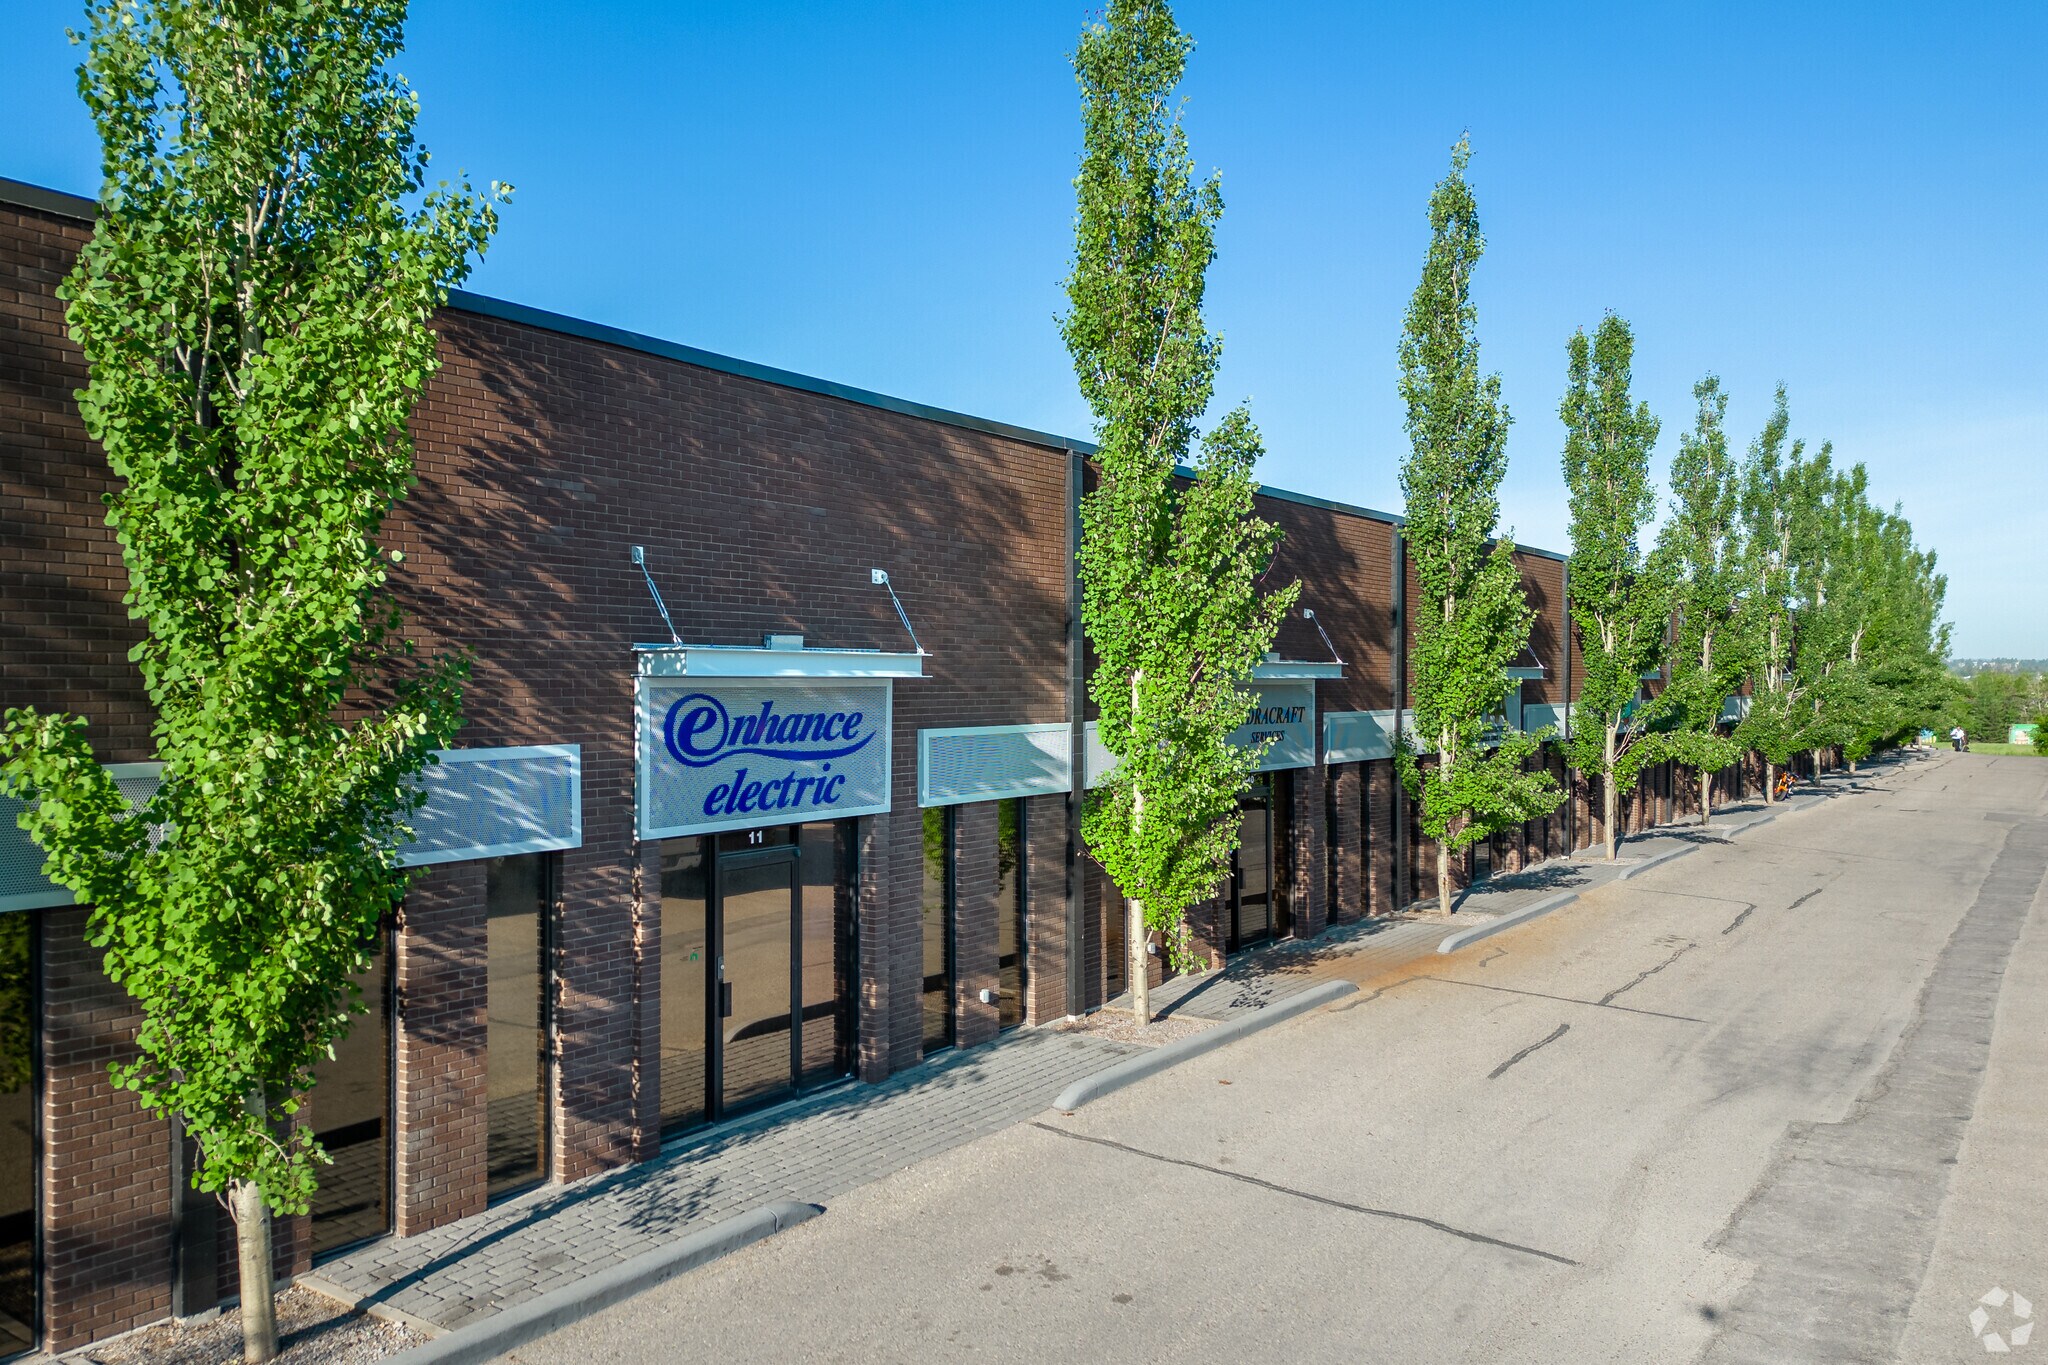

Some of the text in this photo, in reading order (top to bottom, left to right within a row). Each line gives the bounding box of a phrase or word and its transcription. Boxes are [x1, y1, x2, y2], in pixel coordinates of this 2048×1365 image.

[664, 693, 866, 764] enhance
[1240, 706, 1306, 725] DRACRAFT
[703, 763, 846, 816] electric
[748, 830, 763, 845] 11
